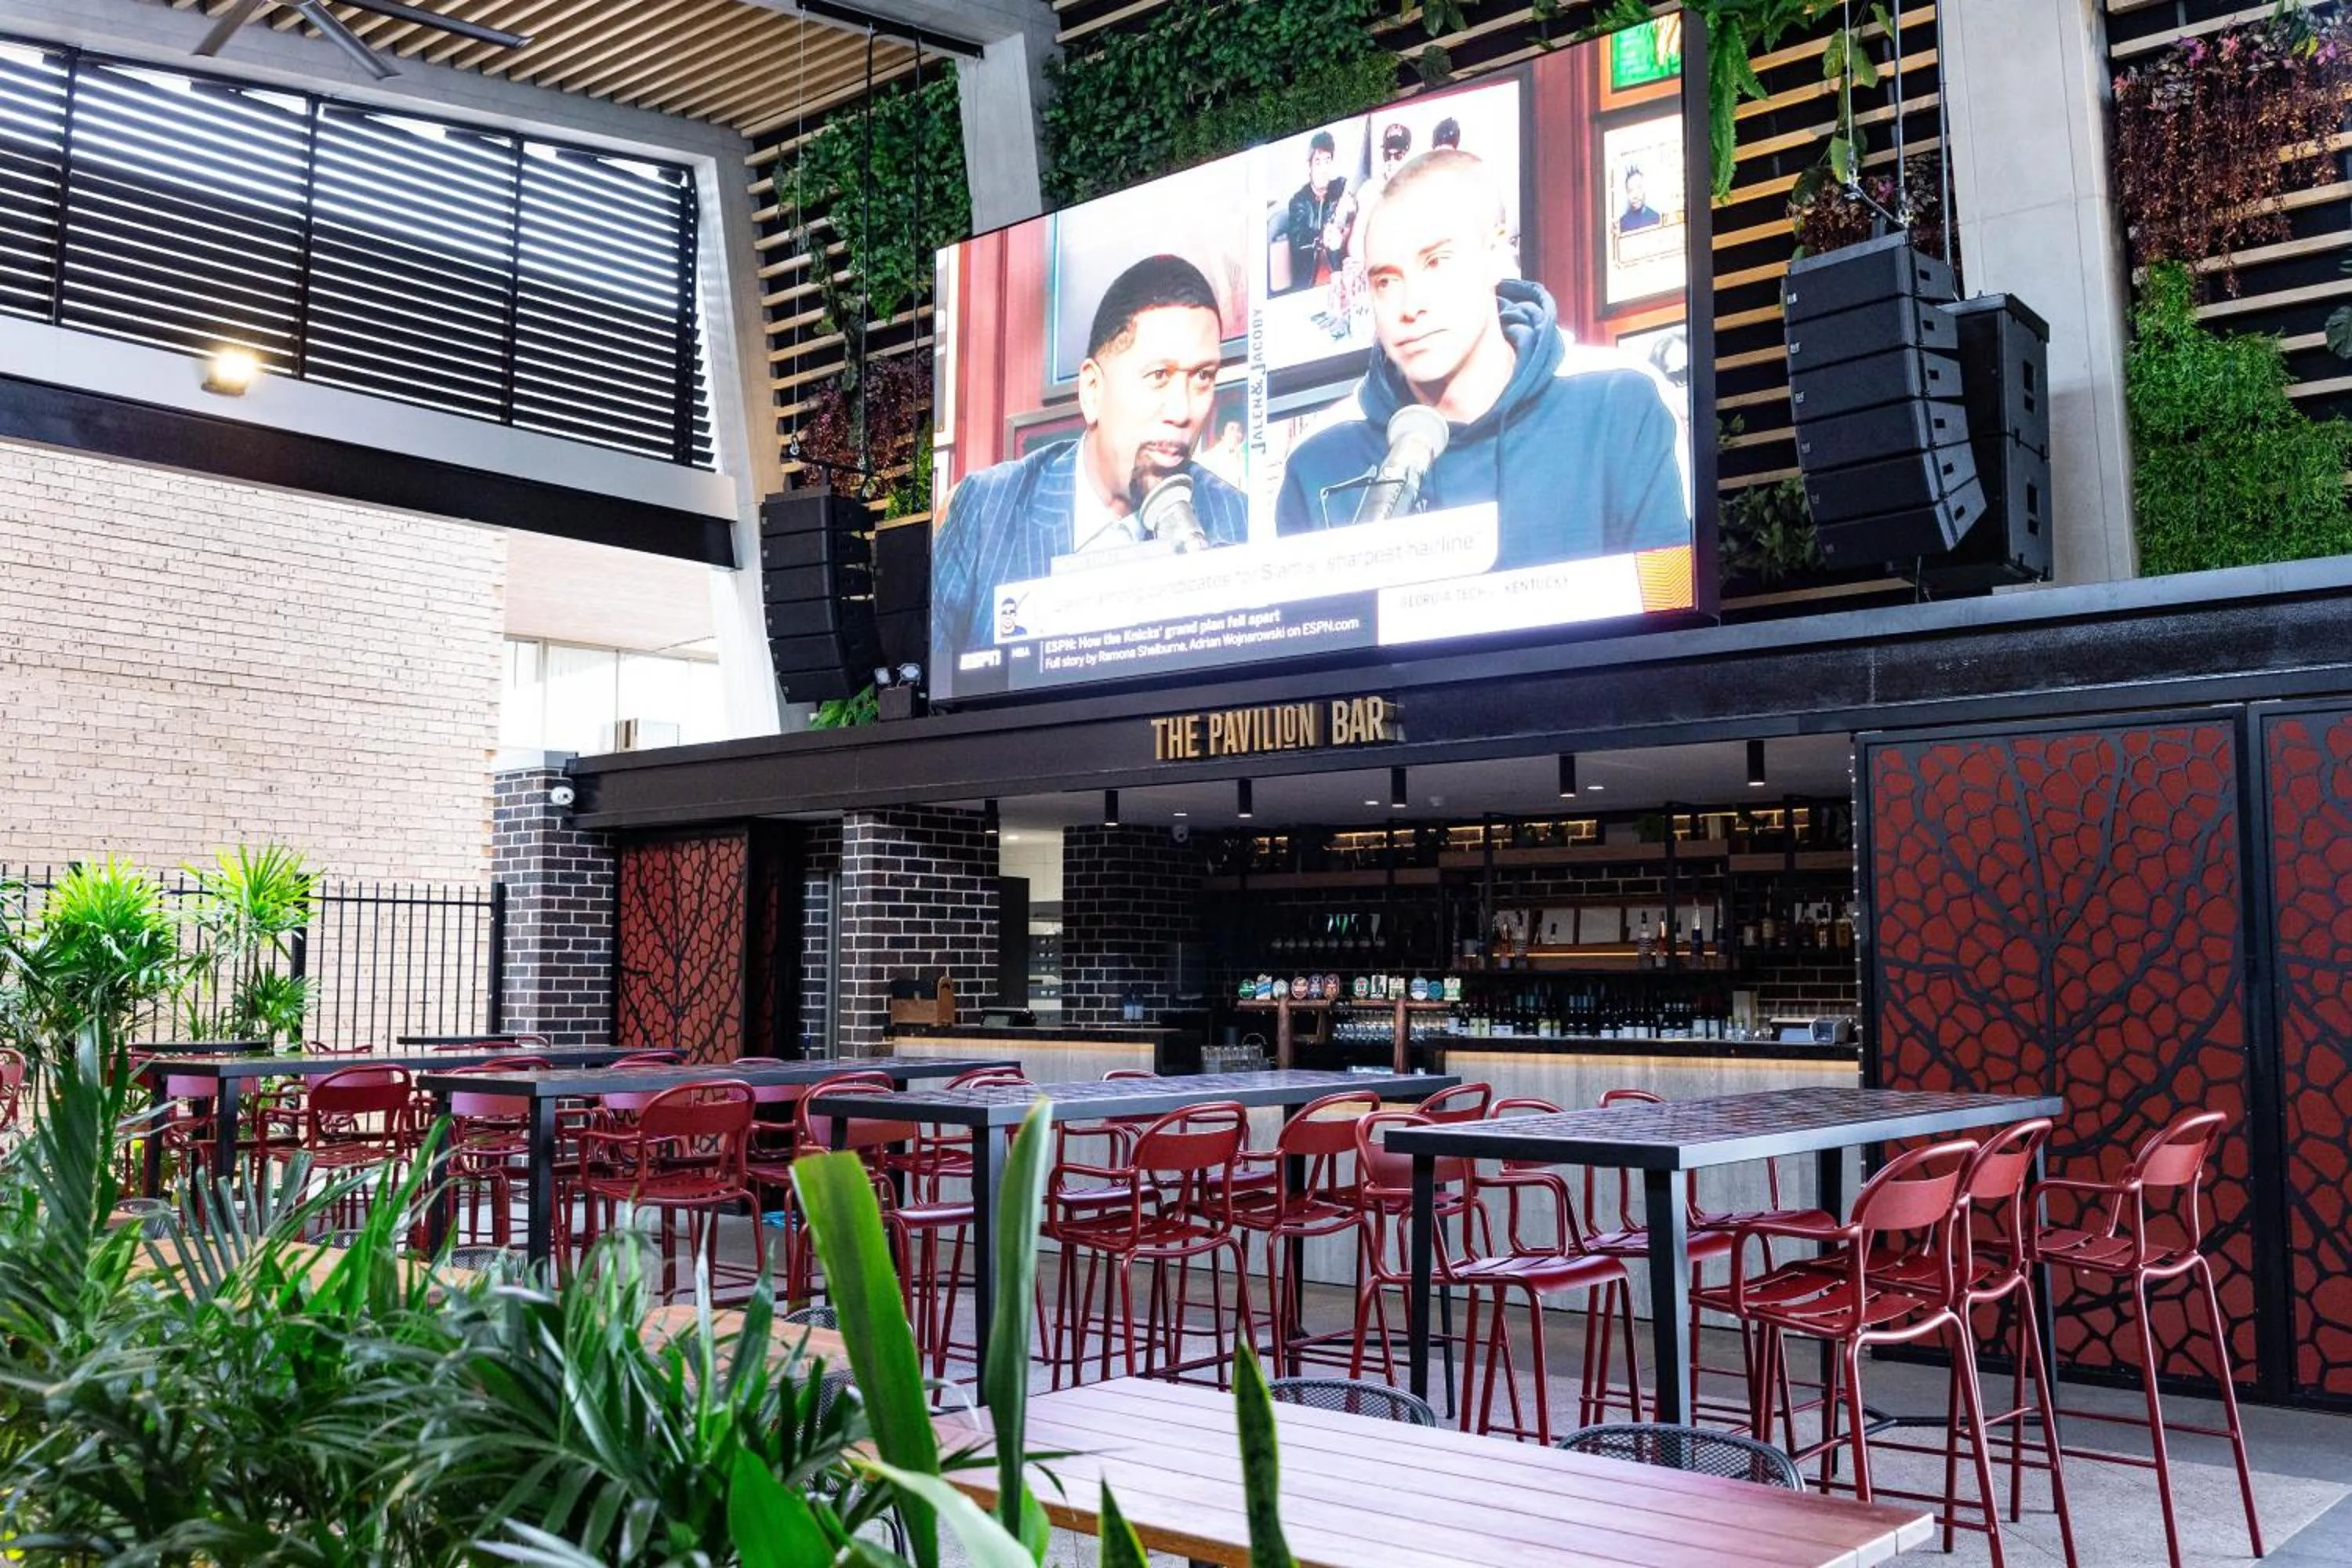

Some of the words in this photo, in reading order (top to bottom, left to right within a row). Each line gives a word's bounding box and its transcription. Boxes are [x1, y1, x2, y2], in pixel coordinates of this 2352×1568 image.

[1045, 637, 1076, 654] ESPN:
[1079, 634, 1102, 649] How
[1104, 630, 1122, 646] the
[1164, 622, 1198, 641] grand
[1200, 618, 1225, 634] plan
[1227, 613, 1246, 629] fell
[1248, 608, 1280, 626] apart
[1045, 657, 1062, 670] Full
[1062, 653, 1084, 669] story
[1086, 652, 1098, 666] by
[1099, 648, 1137, 662] Ramona
[1189, 636, 1221, 652] Adrian
[1222, 626, 1285, 647] Wojnarowski
[1287, 626, 1301, 637] on
[1302, 618, 1360, 635] ESPN.com
[1151, 714, 1200, 760] THE
[1210, 702, 1315, 755] PAVILION
[1333, 695, 1386, 744] BAR
